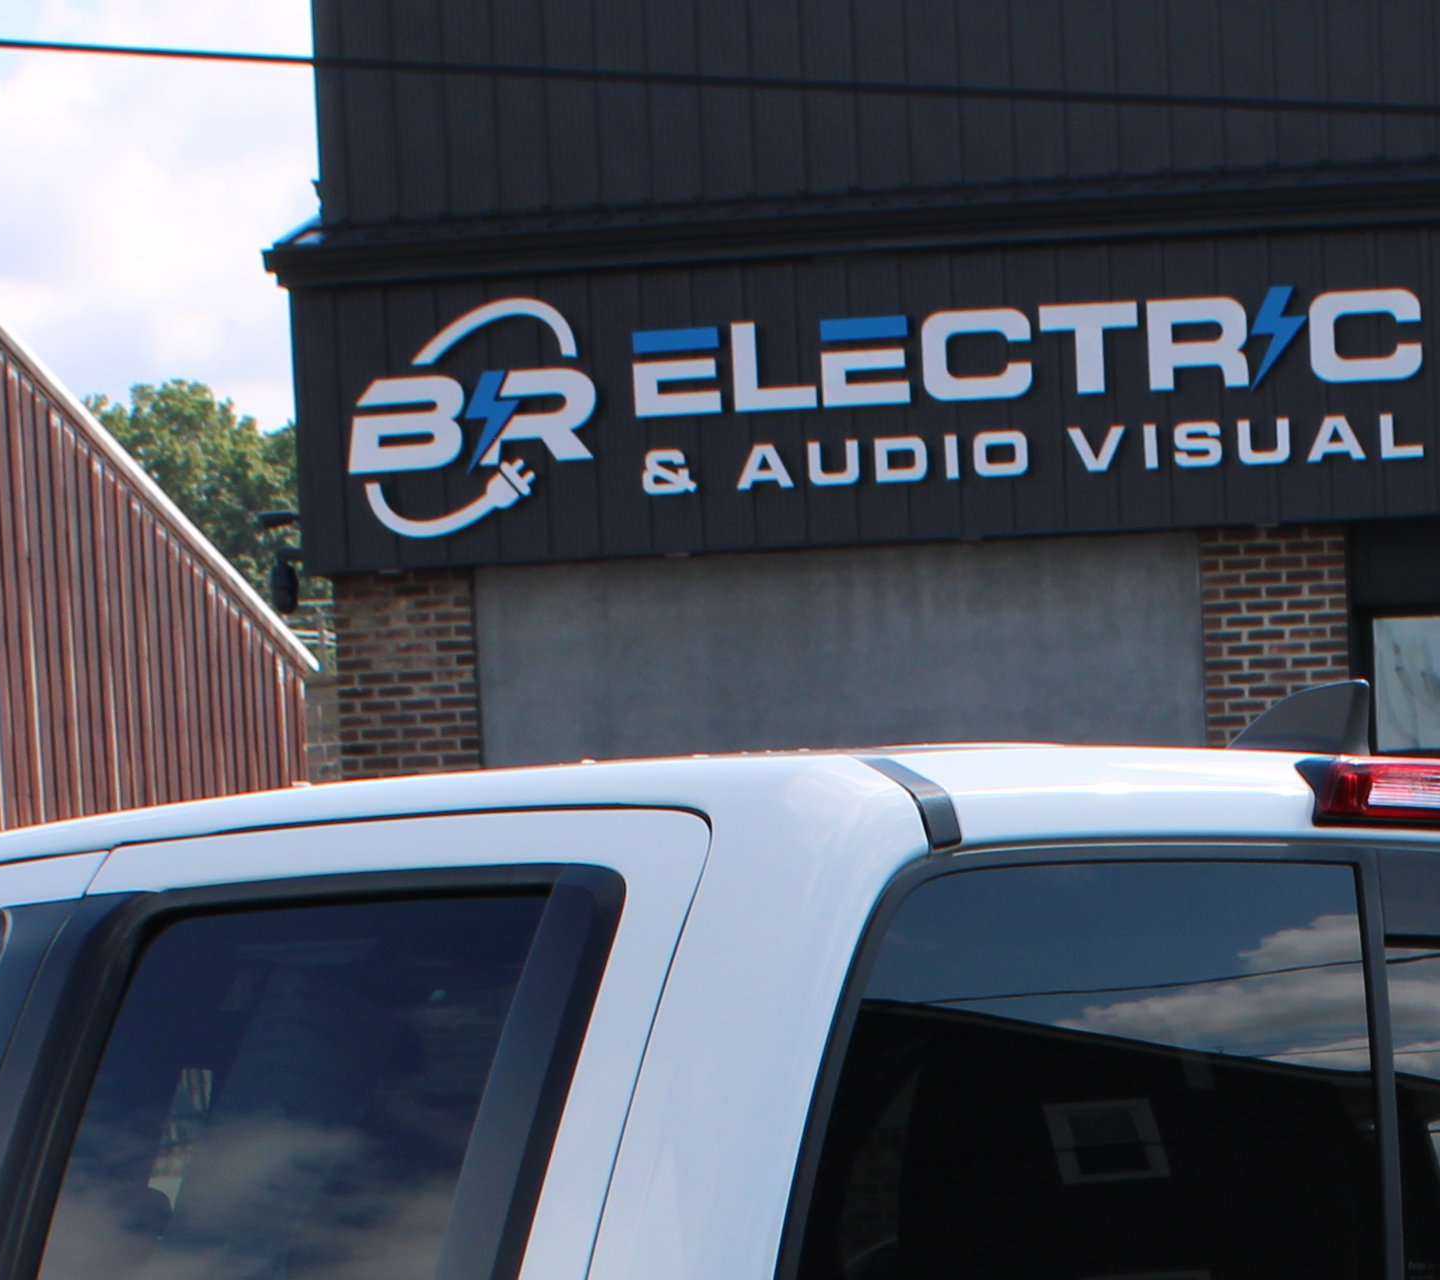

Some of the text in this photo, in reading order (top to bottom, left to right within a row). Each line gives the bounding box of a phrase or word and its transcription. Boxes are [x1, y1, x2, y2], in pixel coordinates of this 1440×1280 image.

[641, 412, 1425, 497] & AUDIO VISUAL
